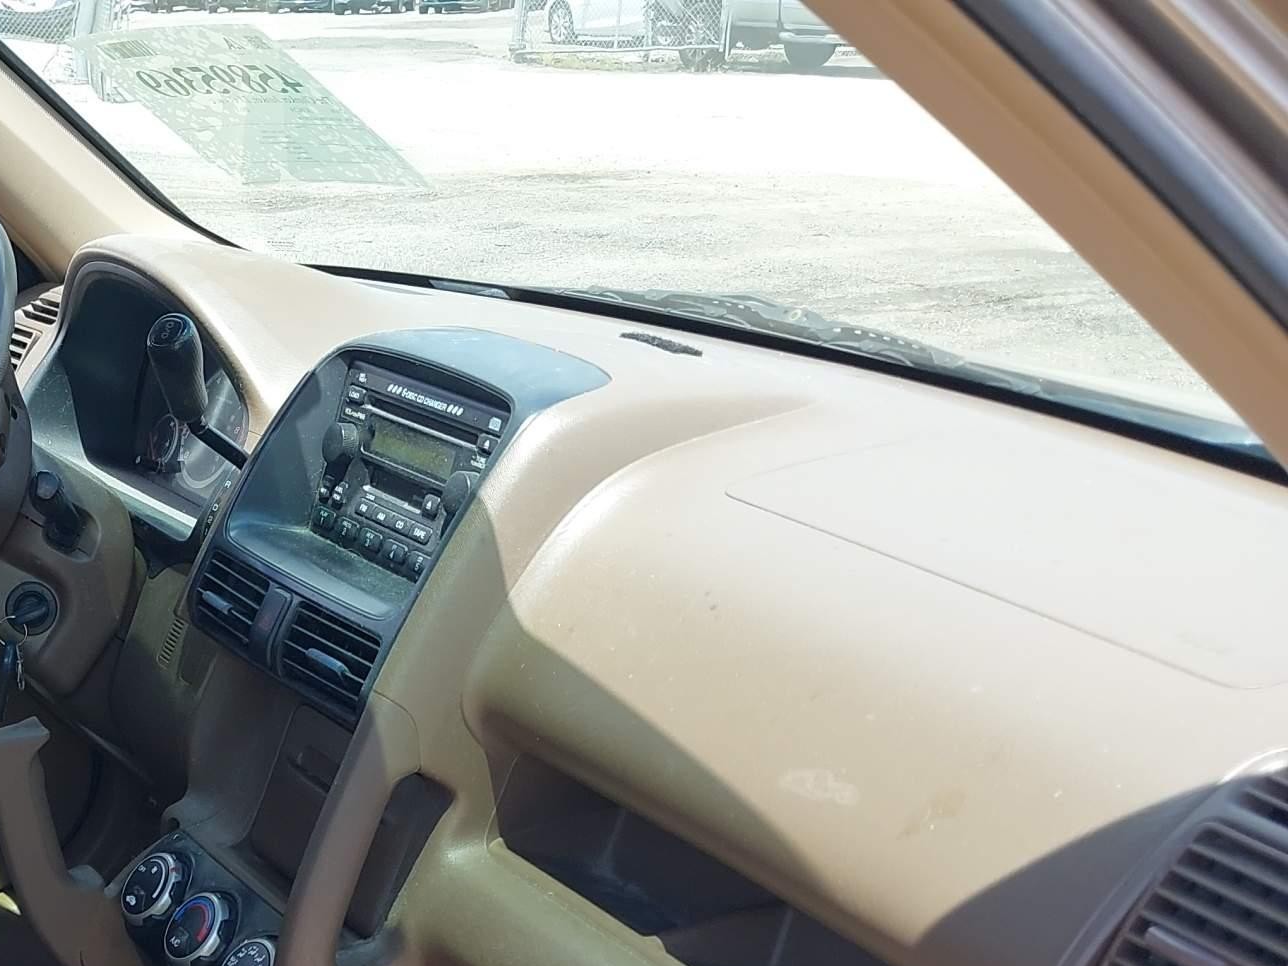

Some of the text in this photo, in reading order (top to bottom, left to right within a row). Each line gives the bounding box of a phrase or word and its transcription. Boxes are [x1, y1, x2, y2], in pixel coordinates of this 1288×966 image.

[423, 396, 448, 412] CHANGER
[395, 520, 405, 529] CD
[413, 528, 427, 539] TAPE
